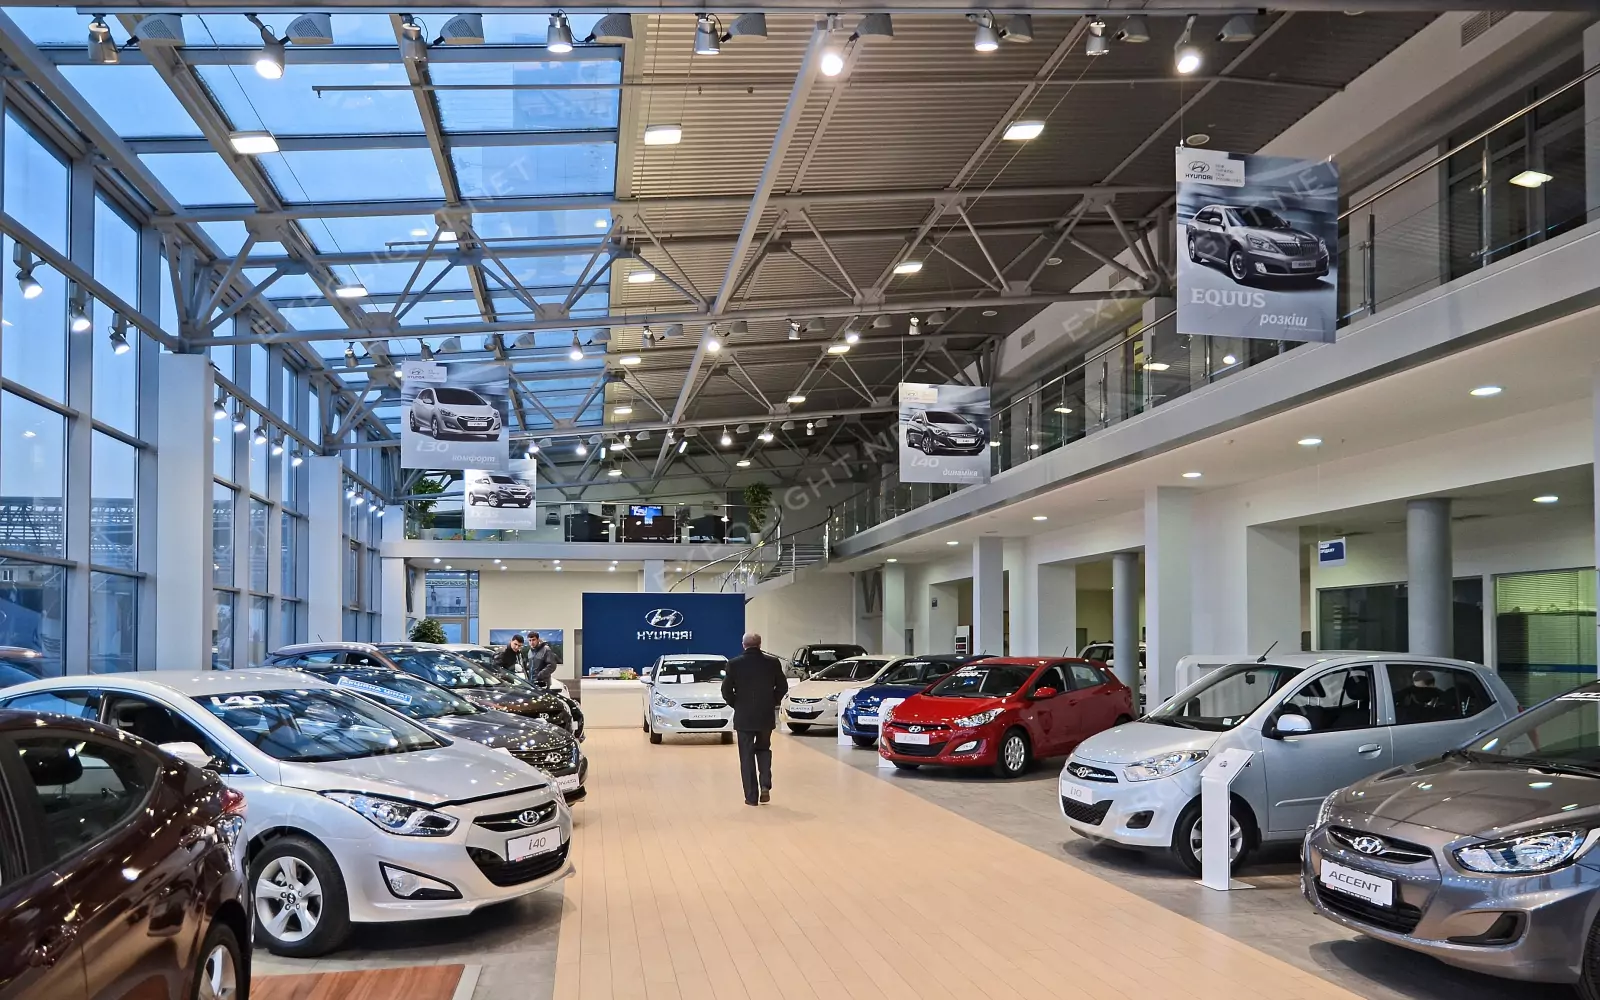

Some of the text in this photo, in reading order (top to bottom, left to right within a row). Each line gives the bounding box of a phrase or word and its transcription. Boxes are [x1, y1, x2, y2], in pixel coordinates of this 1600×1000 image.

[1190, 287, 1266, 308] EQUUS
[1260, 313, 1308, 326] розкіш
[416, 440, 450, 453] i30
[451, 454, 496, 463] комфорт
[910, 454, 940, 468] i40
[636, 630, 693, 640] HYUNDAI
[210, 695, 265, 706] i40
[1070, 786, 1082, 797] i10
[528, 836, 547, 851] i40
[1328, 870, 1382, 893] ACCENT
